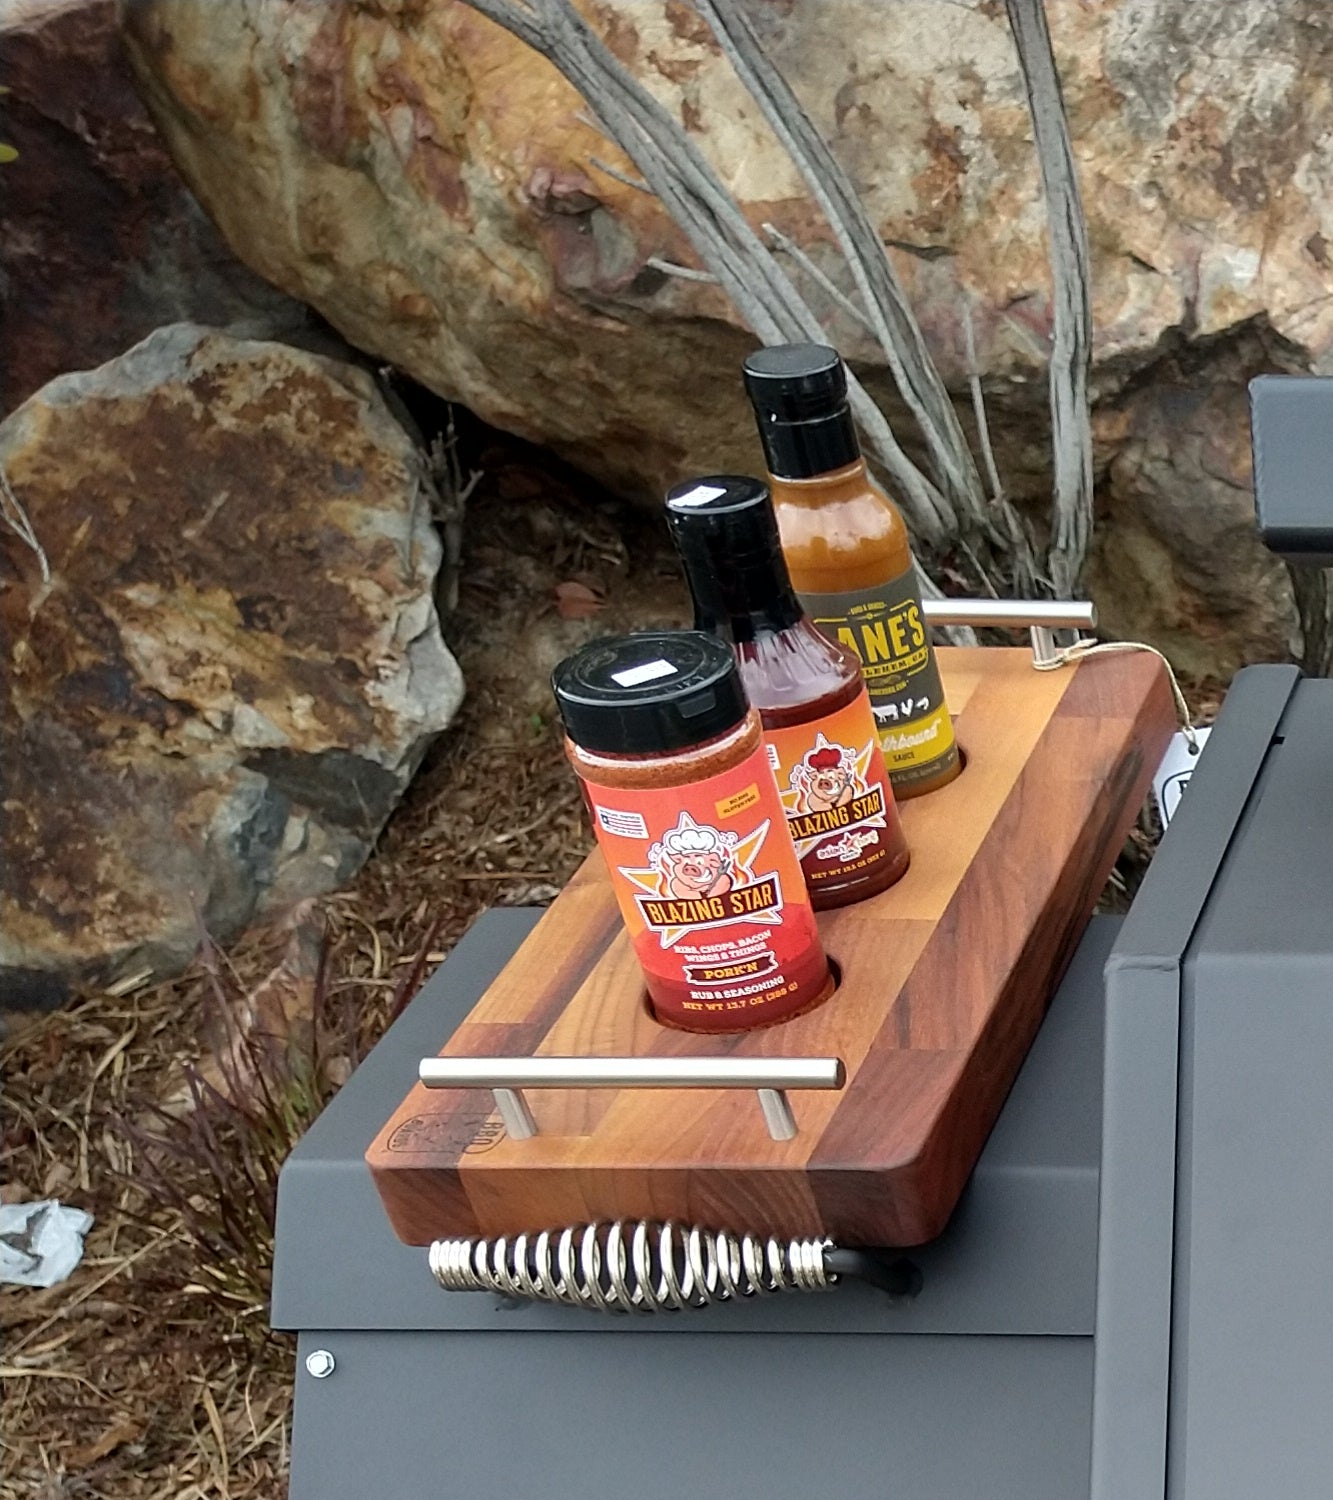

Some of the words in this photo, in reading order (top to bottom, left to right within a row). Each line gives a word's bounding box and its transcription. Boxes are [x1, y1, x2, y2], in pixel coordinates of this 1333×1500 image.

[838, 606, 925, 664] ANE'S
[788, 806, 850, 840] BLAZING
[851, 792, 881, 820] STAR
[647, 897, 725, 924] BLAZING
[730, 884, 773, 914] STAR
[738, 930, 772, 947] BACON
[684, 953, 721, 963] WINGS
[728, 941, 768, 958] THINGS
[703, 961, 759, 980] PORK'N
[690, 990, 714, 1000] RUB
[724, 977, 785, 999] SEASONING
[682, 1001, 703, 1011] NET
[705, 1002, 724, 1011] WT
[727, 1000, 747, 1010] 13.7
[749, 995, 765, 1006] OZ
